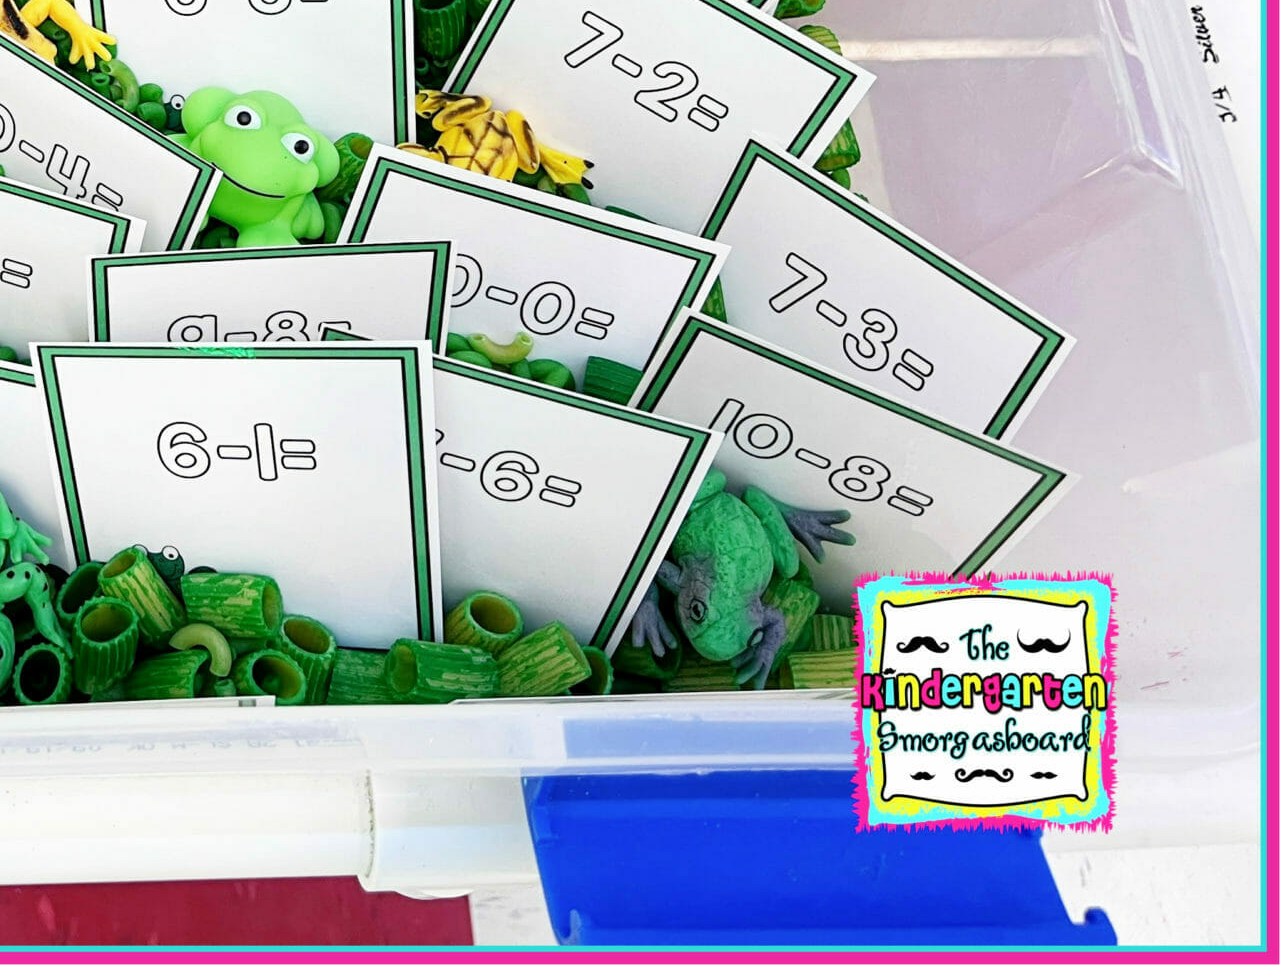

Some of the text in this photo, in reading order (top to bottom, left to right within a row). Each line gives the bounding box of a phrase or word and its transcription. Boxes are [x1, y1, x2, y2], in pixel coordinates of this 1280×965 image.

[563, 10, 730, 133] 7-2=
[768, 251, 935, 392] 7-3=
[156, 421, 318, 482] 6-1=
[435, 429, 583, 509] -6=
[707, 398, 935, 517] 10-8=
